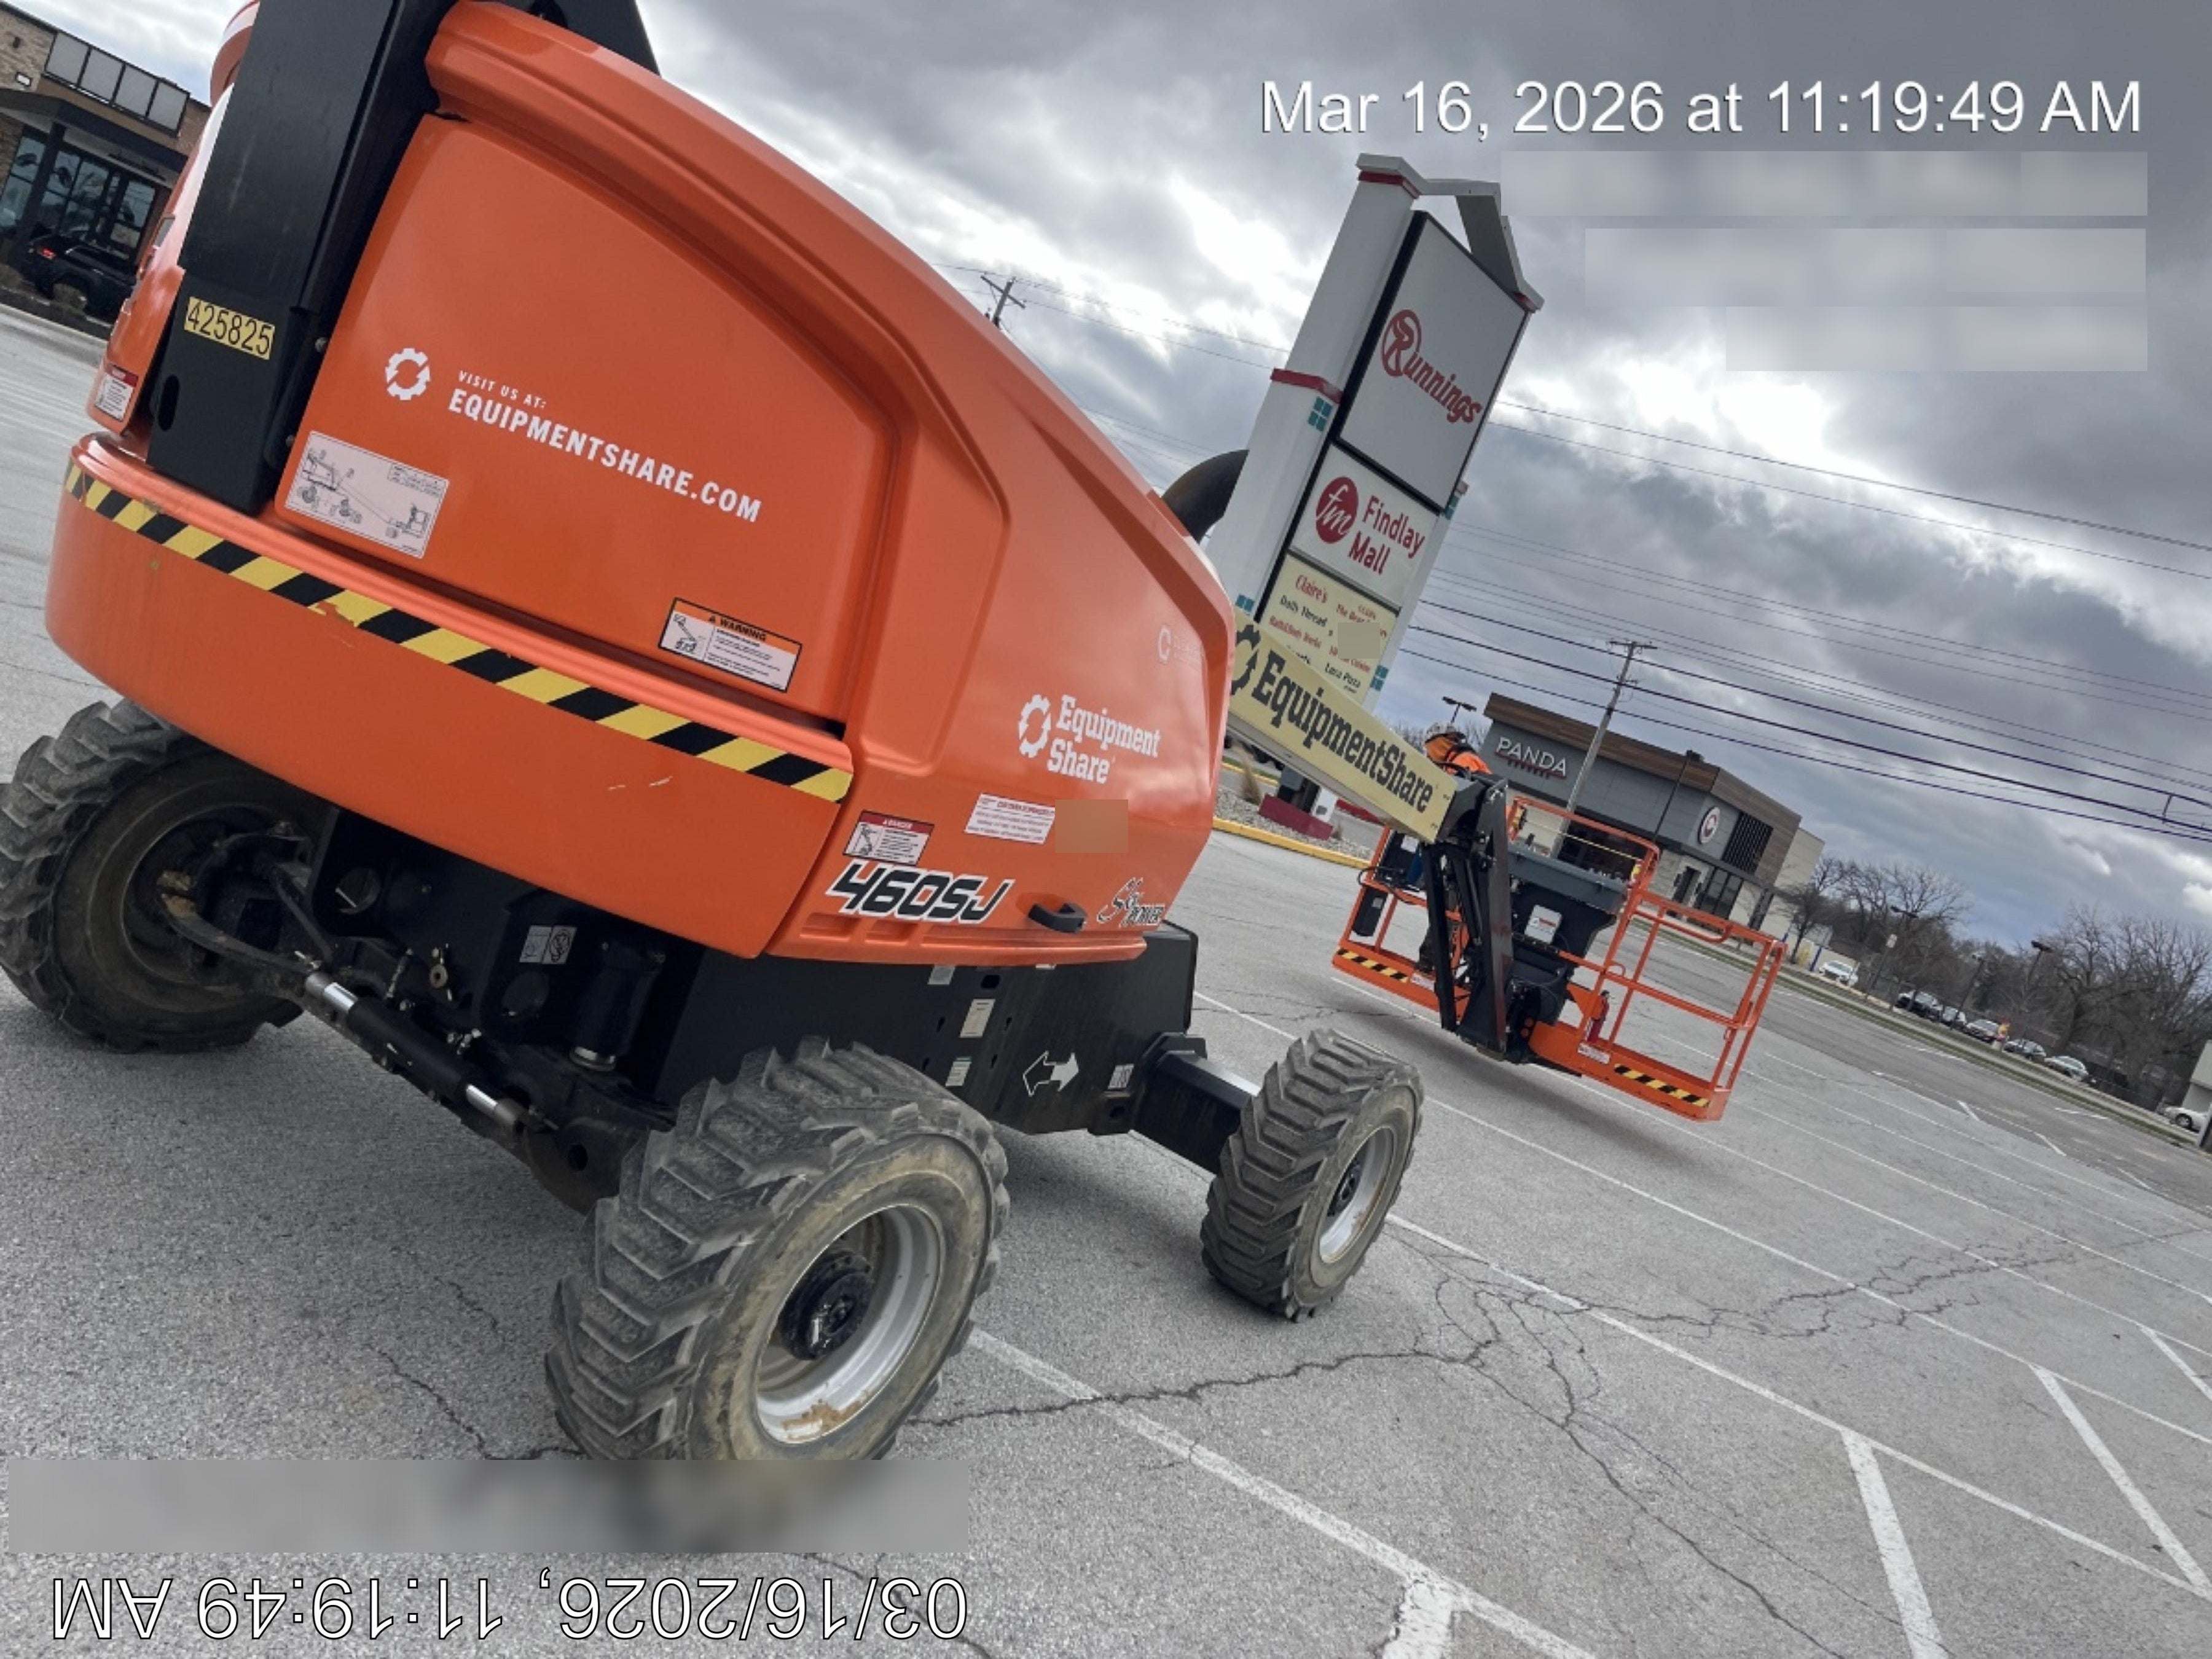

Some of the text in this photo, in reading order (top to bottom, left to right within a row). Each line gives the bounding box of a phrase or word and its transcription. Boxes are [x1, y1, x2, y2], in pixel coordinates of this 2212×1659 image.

[187, 300, 272, 355] 425825
[458, 370, 546, 409] VISIT US AT:
[1381, 309, 1483, 424] Runnings
[447, 388, 762, 523] EQUIPMENTSHARE.COM
[1347, 530, 1390, 576] Mall
[1362, 495, 1426, 559] Findlay
[720, 616, 767, 642] WARNING
[1056, 694, 1161, 758] Equipment
[1251, 649, 1433, 814] EquipmentShare
[1046, 737, 1111, 785] Share
[1496, 736, 1566, 777] PANDA
[826, 858, 1016, 924] 460SJ
